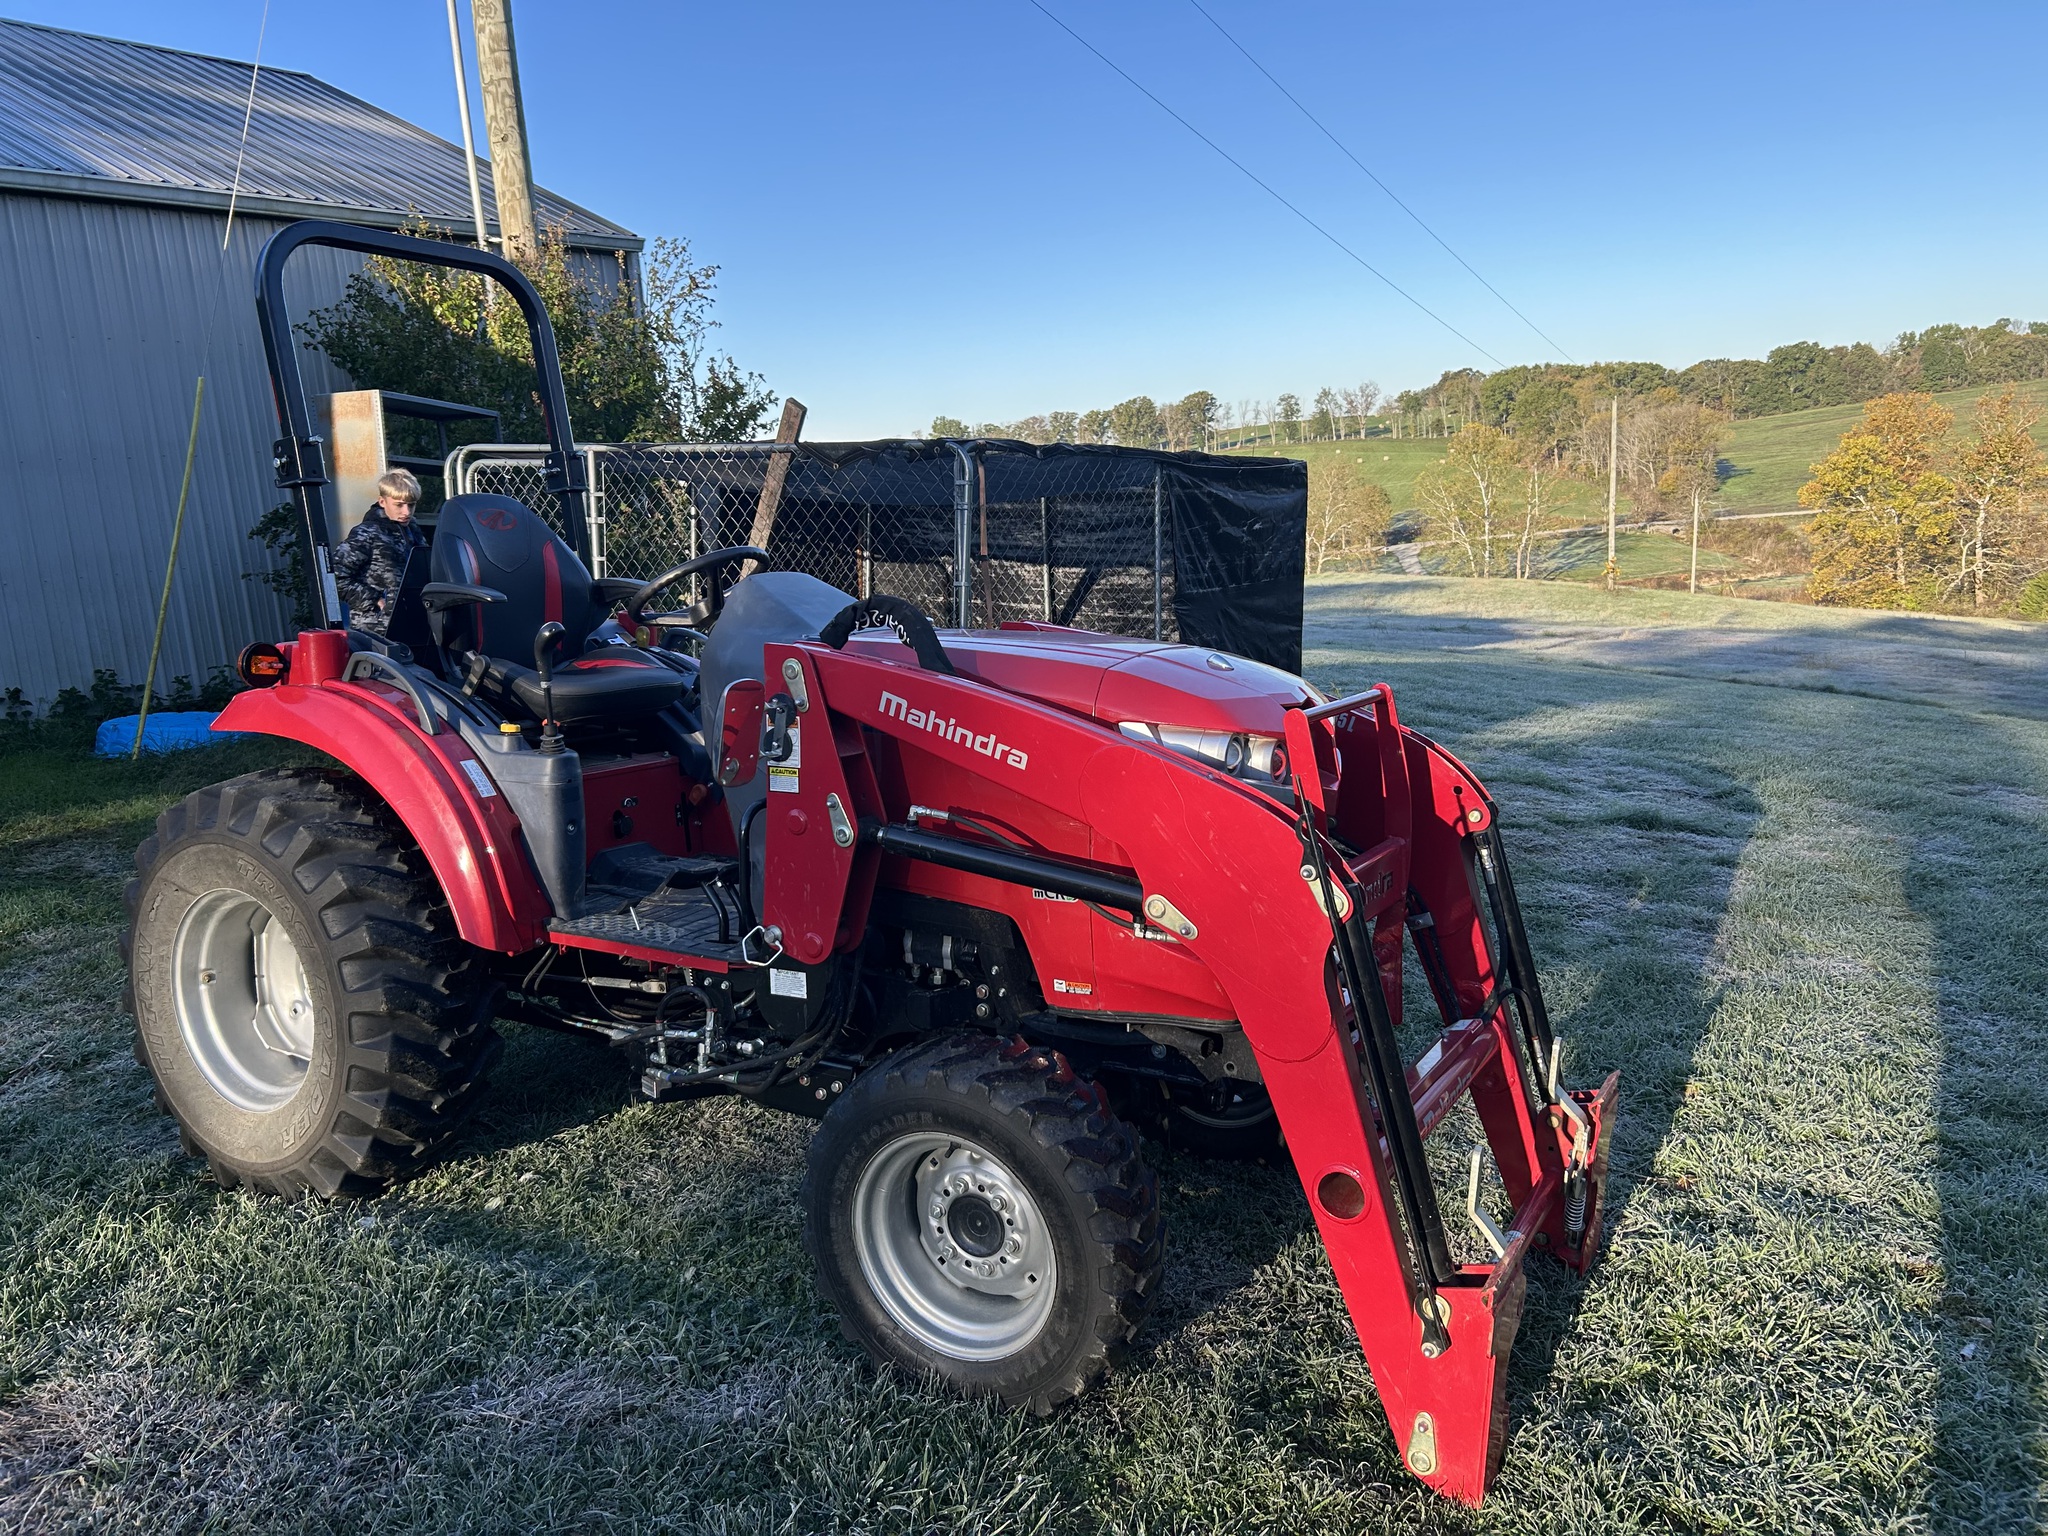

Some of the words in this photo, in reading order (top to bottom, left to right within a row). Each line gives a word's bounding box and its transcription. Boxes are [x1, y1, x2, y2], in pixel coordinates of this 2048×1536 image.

[878, 690, 1029, 770] Mahindra
[137, 931, 174, 1076] TITAN
[237, 857, 315, 950] TRAC
[281, 974, 334, 1150] LOADER
[861, 1111, 934, 1145] LOADER
